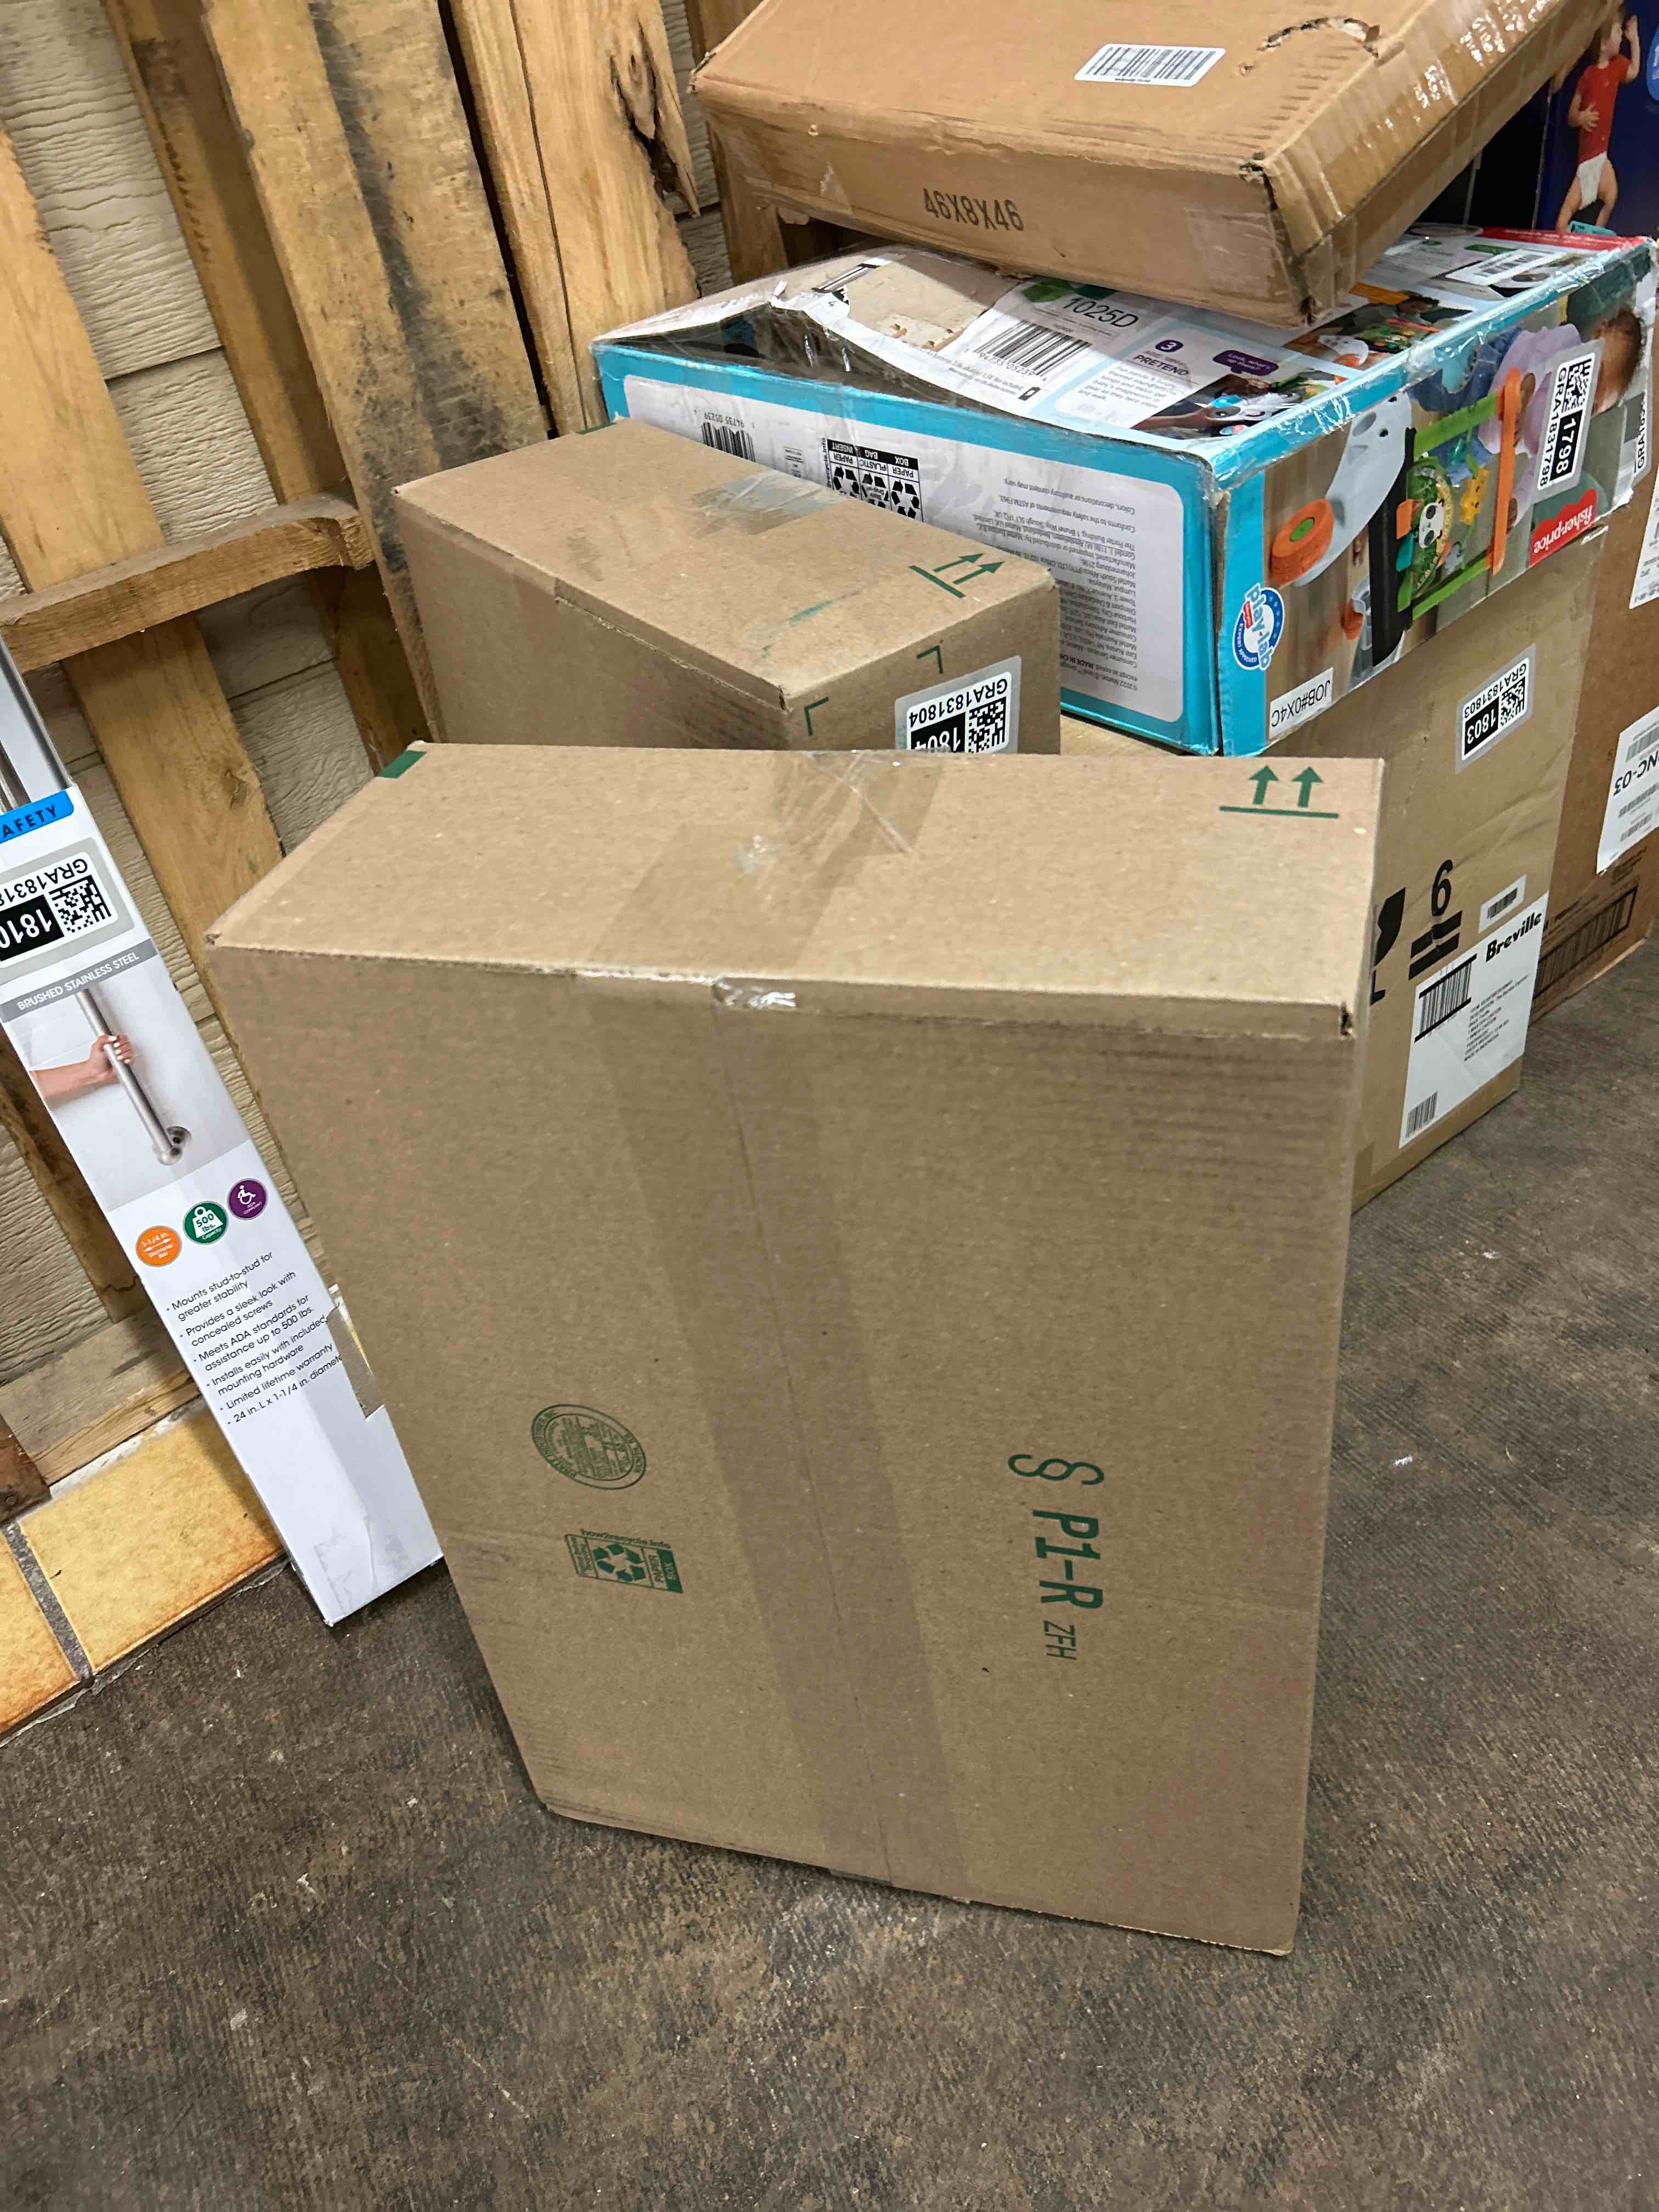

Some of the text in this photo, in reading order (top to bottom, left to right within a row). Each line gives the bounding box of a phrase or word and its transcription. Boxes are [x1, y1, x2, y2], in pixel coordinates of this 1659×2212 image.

[923, 188, 1024, 231] 46X8X46
[1063, 298, 1139, 328] 1025D
[1133, 354, 1189, 376] PRETEND
[1161, 342, 1177, 351] 3
[832, 443, 854, 454] INSERT
[1540, 367, 1567, 487] GRA1831798
[1556, 417, 1576, 474] 1798
[833, 453, 853, 464] PAPER
[859, 459, 887, 472] PLASTIC
[865, 449, 878, 460] BAG
[891, 466, 913, 478] PAPER
[895, 456, 909, 466] BOX
[1534, 505, 1594, 554] fisher-price
[909, 679, 1008, 728] GRA1831804
[1464, 663, 1527, 719] GRA1831803
[1467, 709, 1496, 744] 1803
[1431, 859, 1454, 917] 6
[1486, 910, 1542, 963] Breville
[17, 952, 140, 1011] BRUSHED STAINLESS STEEL
[196, 1213, 214, 1227] 500
[202, 1224, 216, 1233] lbs.
[202, 1227, 222, 1240] Capacity
[172, 1252, 273, 1311] Mounts stud-to-stud for
[178, 1281, 249, 1322] greater stability
[185, 1312, 224, 1336] Provides
[235, 1294, 259, 1312] sleek
[259, 1283, 277, 1299] look
[278, 1271, 296, 1286] with
[191, 1300, 273, 1347] concealed screws
[199, 1295, 309, 1361] Meets ADA standards for
[205, 1306, 314, 1371] assistance up to 500 lbs.
[212, 1365, 243, 1385] Installs
[245, 1351, 270, 1369] easily
[272, 1339, 290, 1355] with
[218, 1345, 303, 1396] mounting hardware
[226, 1343, 334, 1409] Limited lifetime warranty
[234, 1412, 246, 1423] 24
[247, 1404, 258, 1415] in.
[259, 1401, 266, 1409] L
[274, 1384, 298, 1401] 1-1/4
[298, 1377, 310, 1387] in.
[310, 1355, 343, 1380] diamete
[648, 1554, 665, 1583] PAPER
[663, 1562, 677, 1581] BOX
[1031, 1509, 1103, 1610] P1-R
[1043, 1620, 1077, 1661] ZFH
